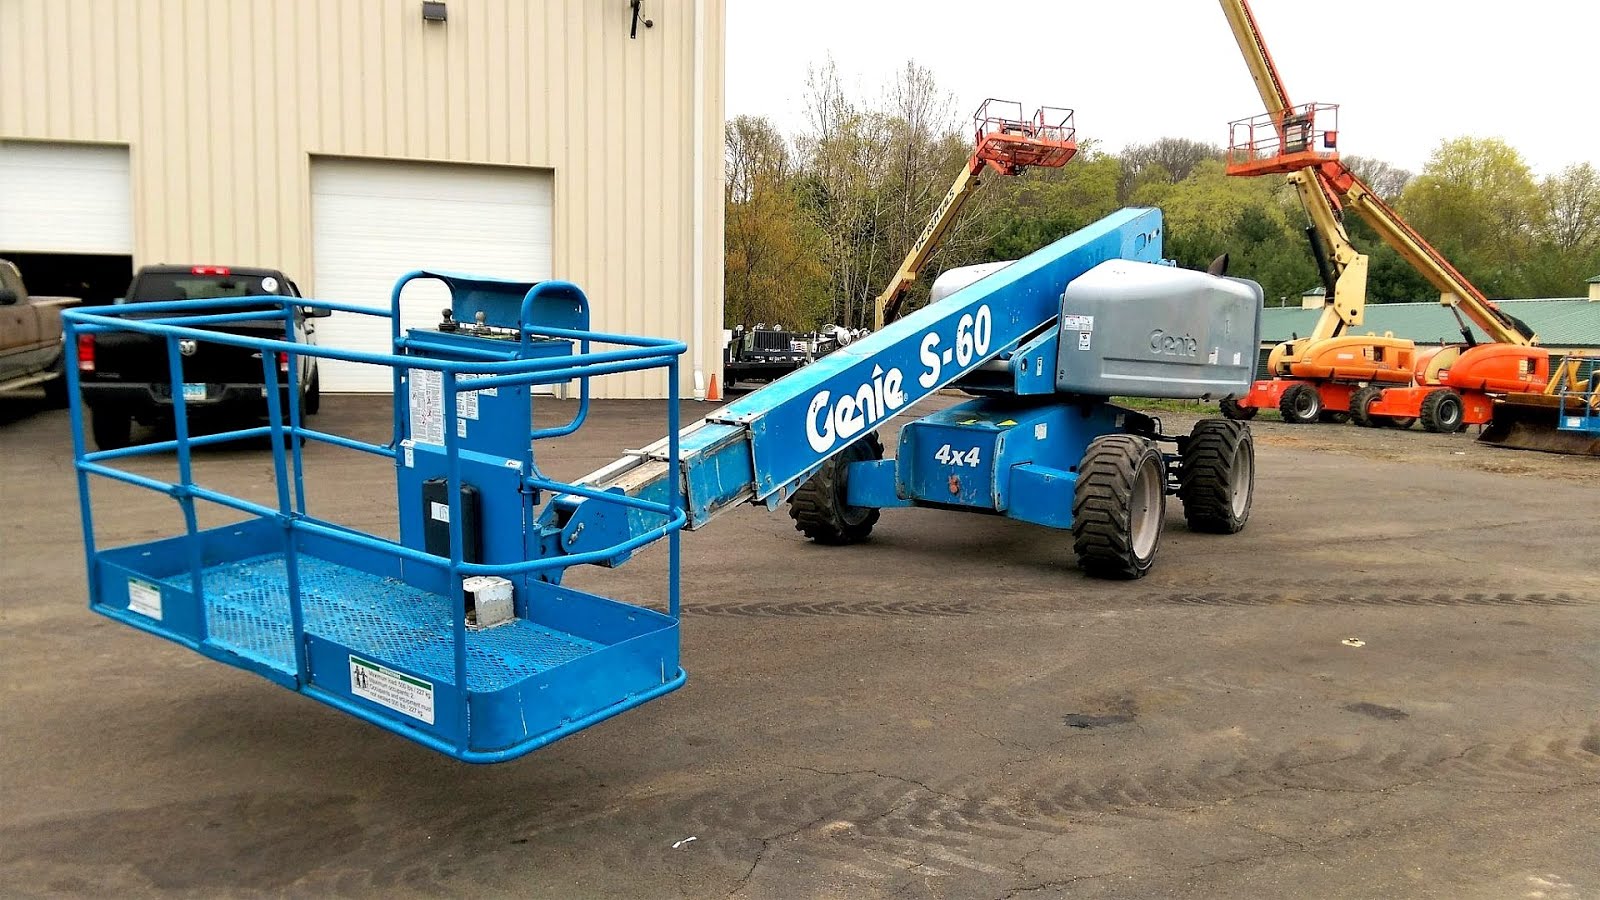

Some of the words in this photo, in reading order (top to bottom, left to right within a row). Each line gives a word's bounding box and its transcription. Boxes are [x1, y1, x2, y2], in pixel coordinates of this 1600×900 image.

[1149, 328, 1197, 357] Genie
[806, 364, 904, 453] Genie
[919, 304, 992, 389] S-60
[935, 444, 980, 468] 4x4
